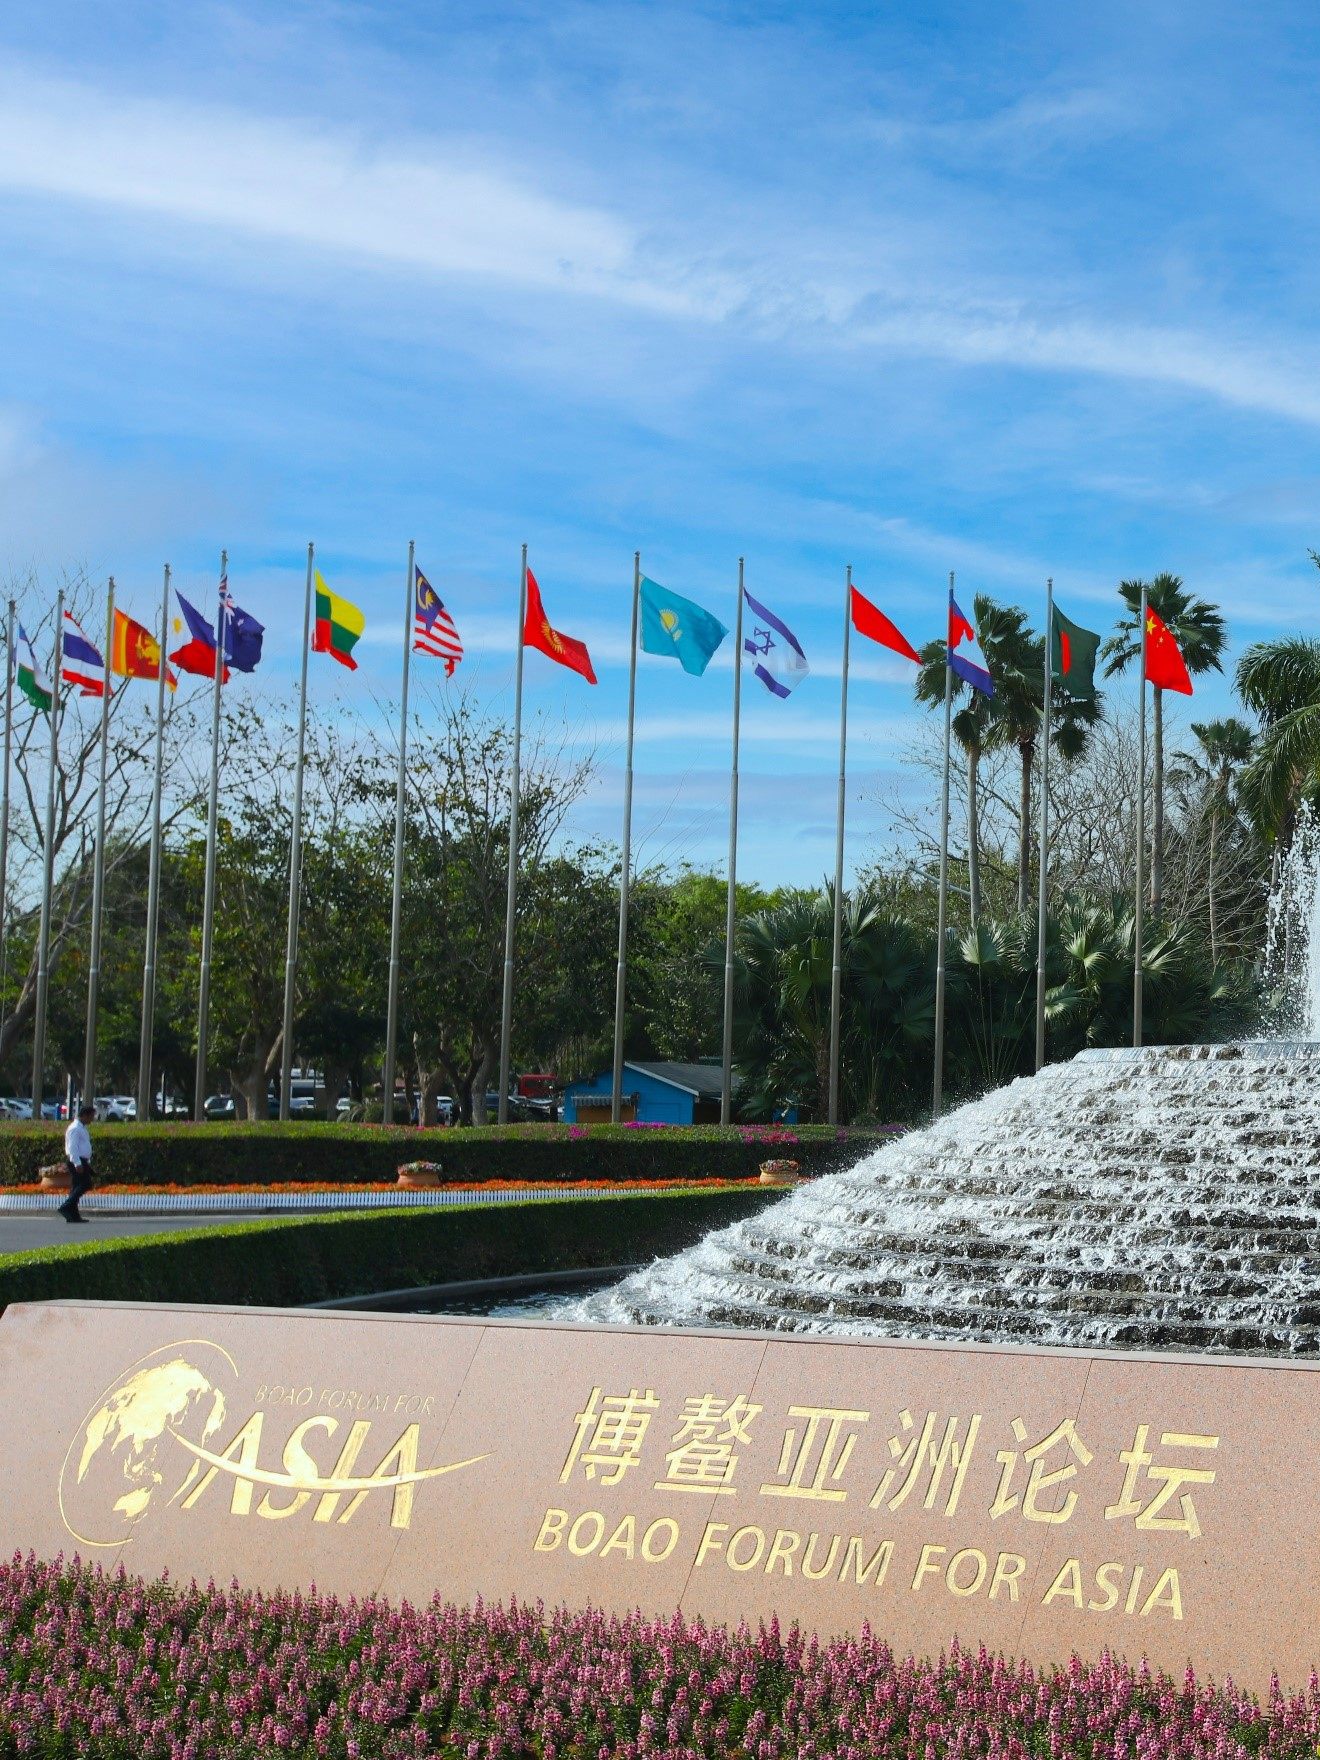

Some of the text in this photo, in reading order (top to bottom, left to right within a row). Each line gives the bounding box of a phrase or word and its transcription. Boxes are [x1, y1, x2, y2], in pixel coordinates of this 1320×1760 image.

[255, 1384, 435, 1415] BOAO FORUM FOR
[181, 1410, 420, 1530] ASIA
[559, 1386, 1221, 1540] 博鳌亚洲论坛
[533, 1508, 1184, 1620] BOAO FORUM FOR ASIA
